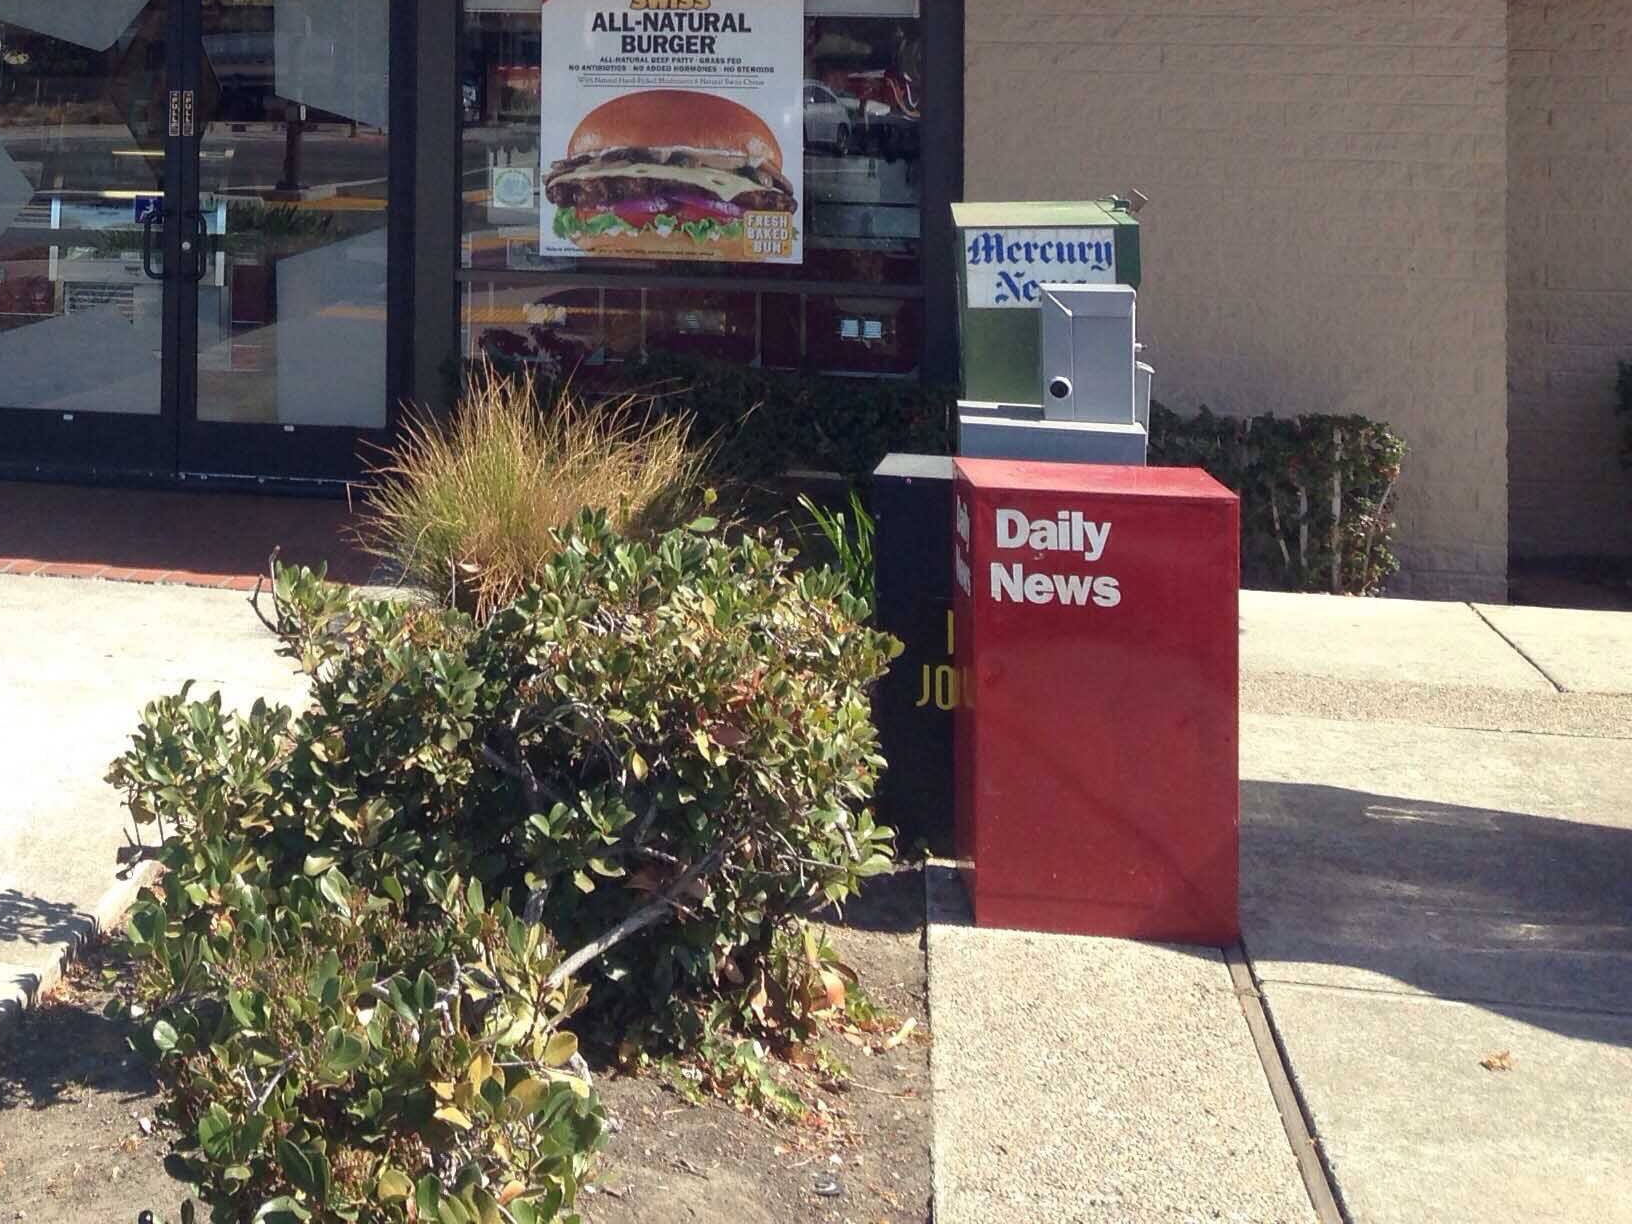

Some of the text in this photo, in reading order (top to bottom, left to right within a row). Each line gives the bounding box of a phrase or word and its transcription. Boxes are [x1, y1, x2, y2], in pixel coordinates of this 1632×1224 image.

[591, 12, 752, 33] ALL-NATURAL
[620, 34, 717, 55] BURGER
[747, 215, 788, 226] FRESH
[747, 229, 789, 241] BAKED
[752, 242, 782, 254] BUN
[967, 231, 1113, 272] Mercury
[995, 509, 1112, 561] Daily
[989, 562, 1122, 608] News
